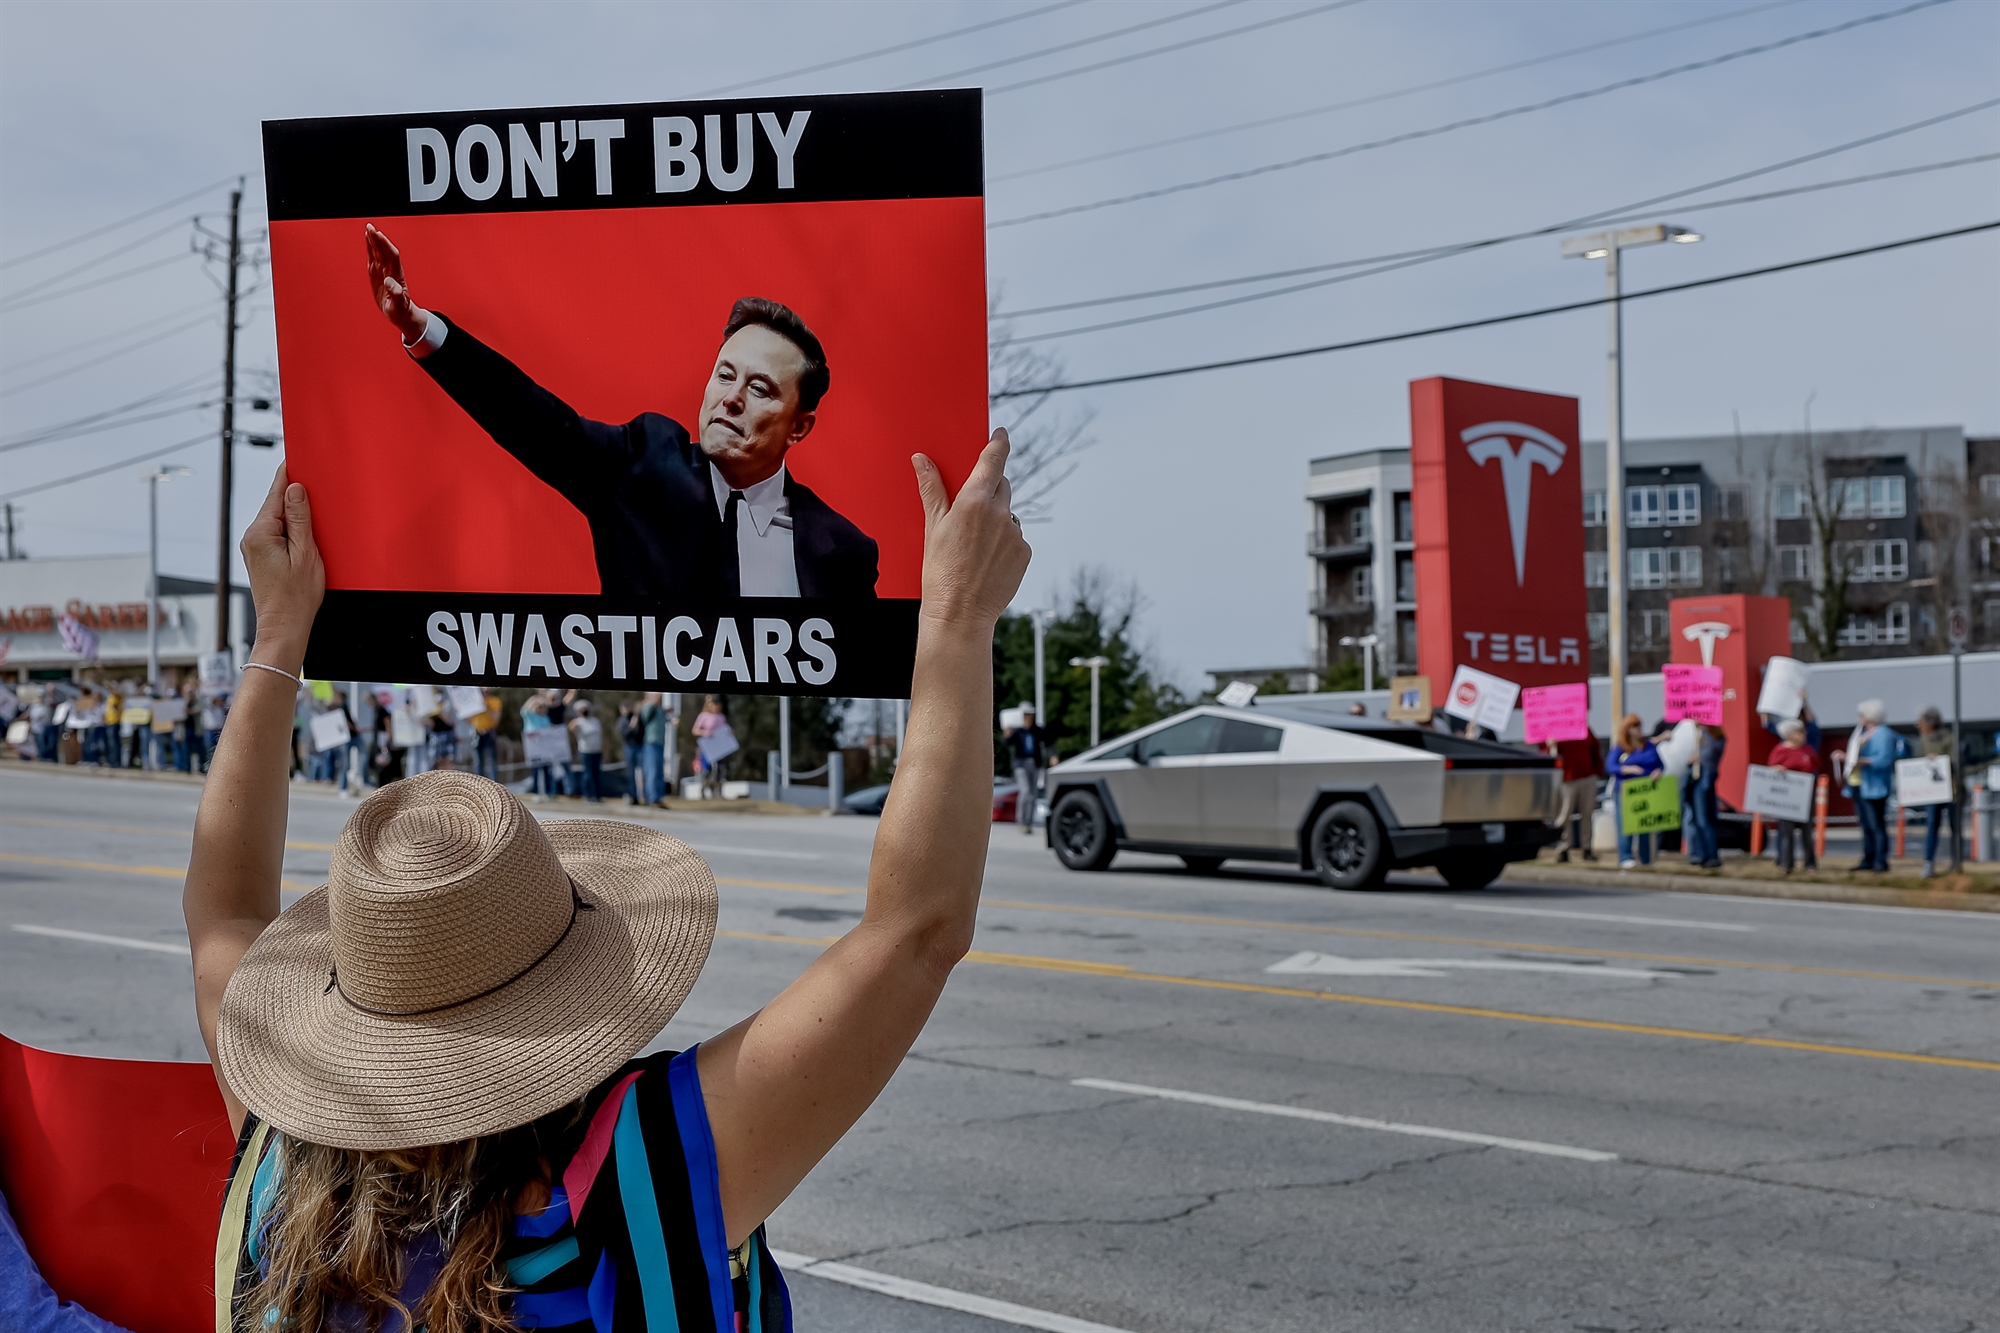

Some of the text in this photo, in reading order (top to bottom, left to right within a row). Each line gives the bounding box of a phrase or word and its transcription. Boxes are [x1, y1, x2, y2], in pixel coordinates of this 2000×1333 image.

[405, 110, 812, 203] DON'T BUY
[426, 610, 838, 686] SWASTICARS
[1463, 631, 1580, 665] TESLA
